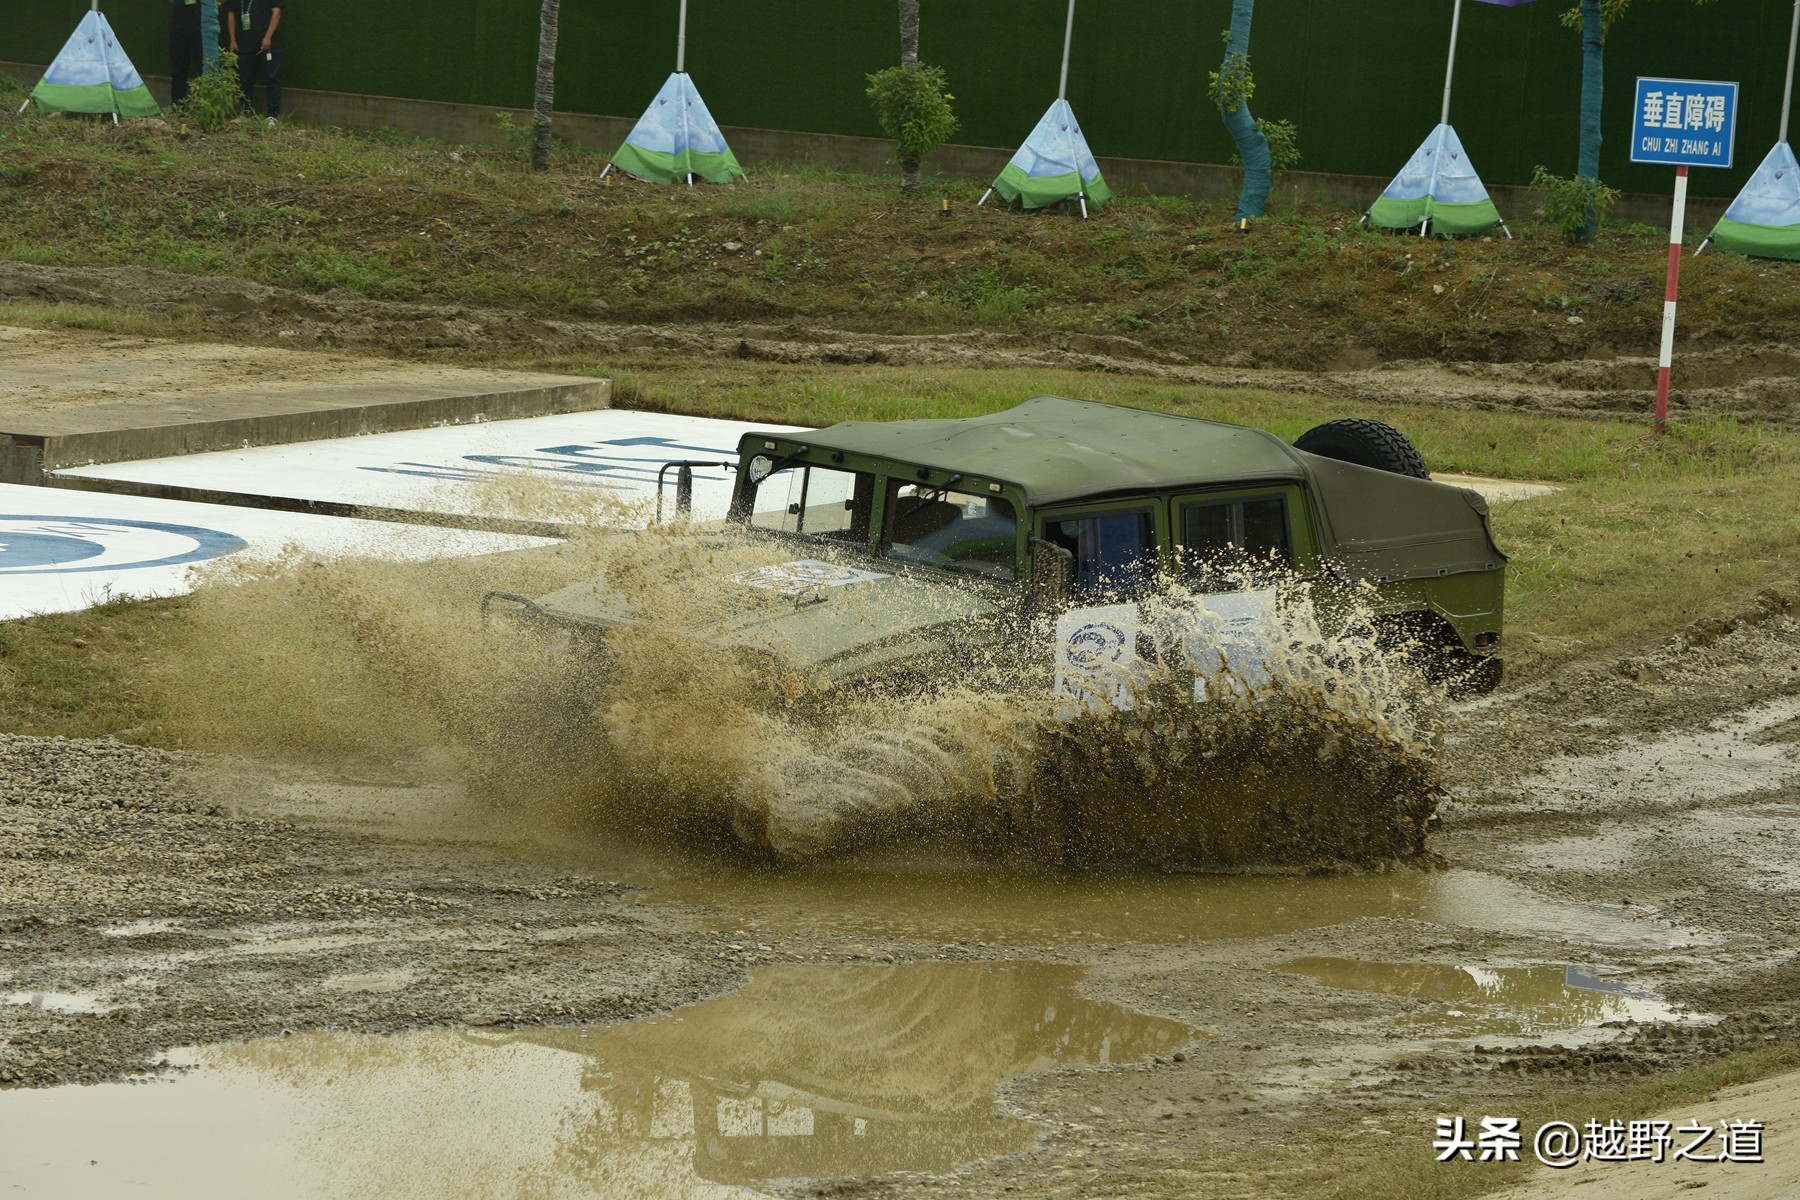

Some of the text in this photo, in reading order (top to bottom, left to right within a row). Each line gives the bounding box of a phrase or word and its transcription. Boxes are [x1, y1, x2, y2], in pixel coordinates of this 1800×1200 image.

[1643, 91, 1725, 132] 垂直障碍
[1641, 137, 1722, 156] CHUI ZHI ZHANG AI
